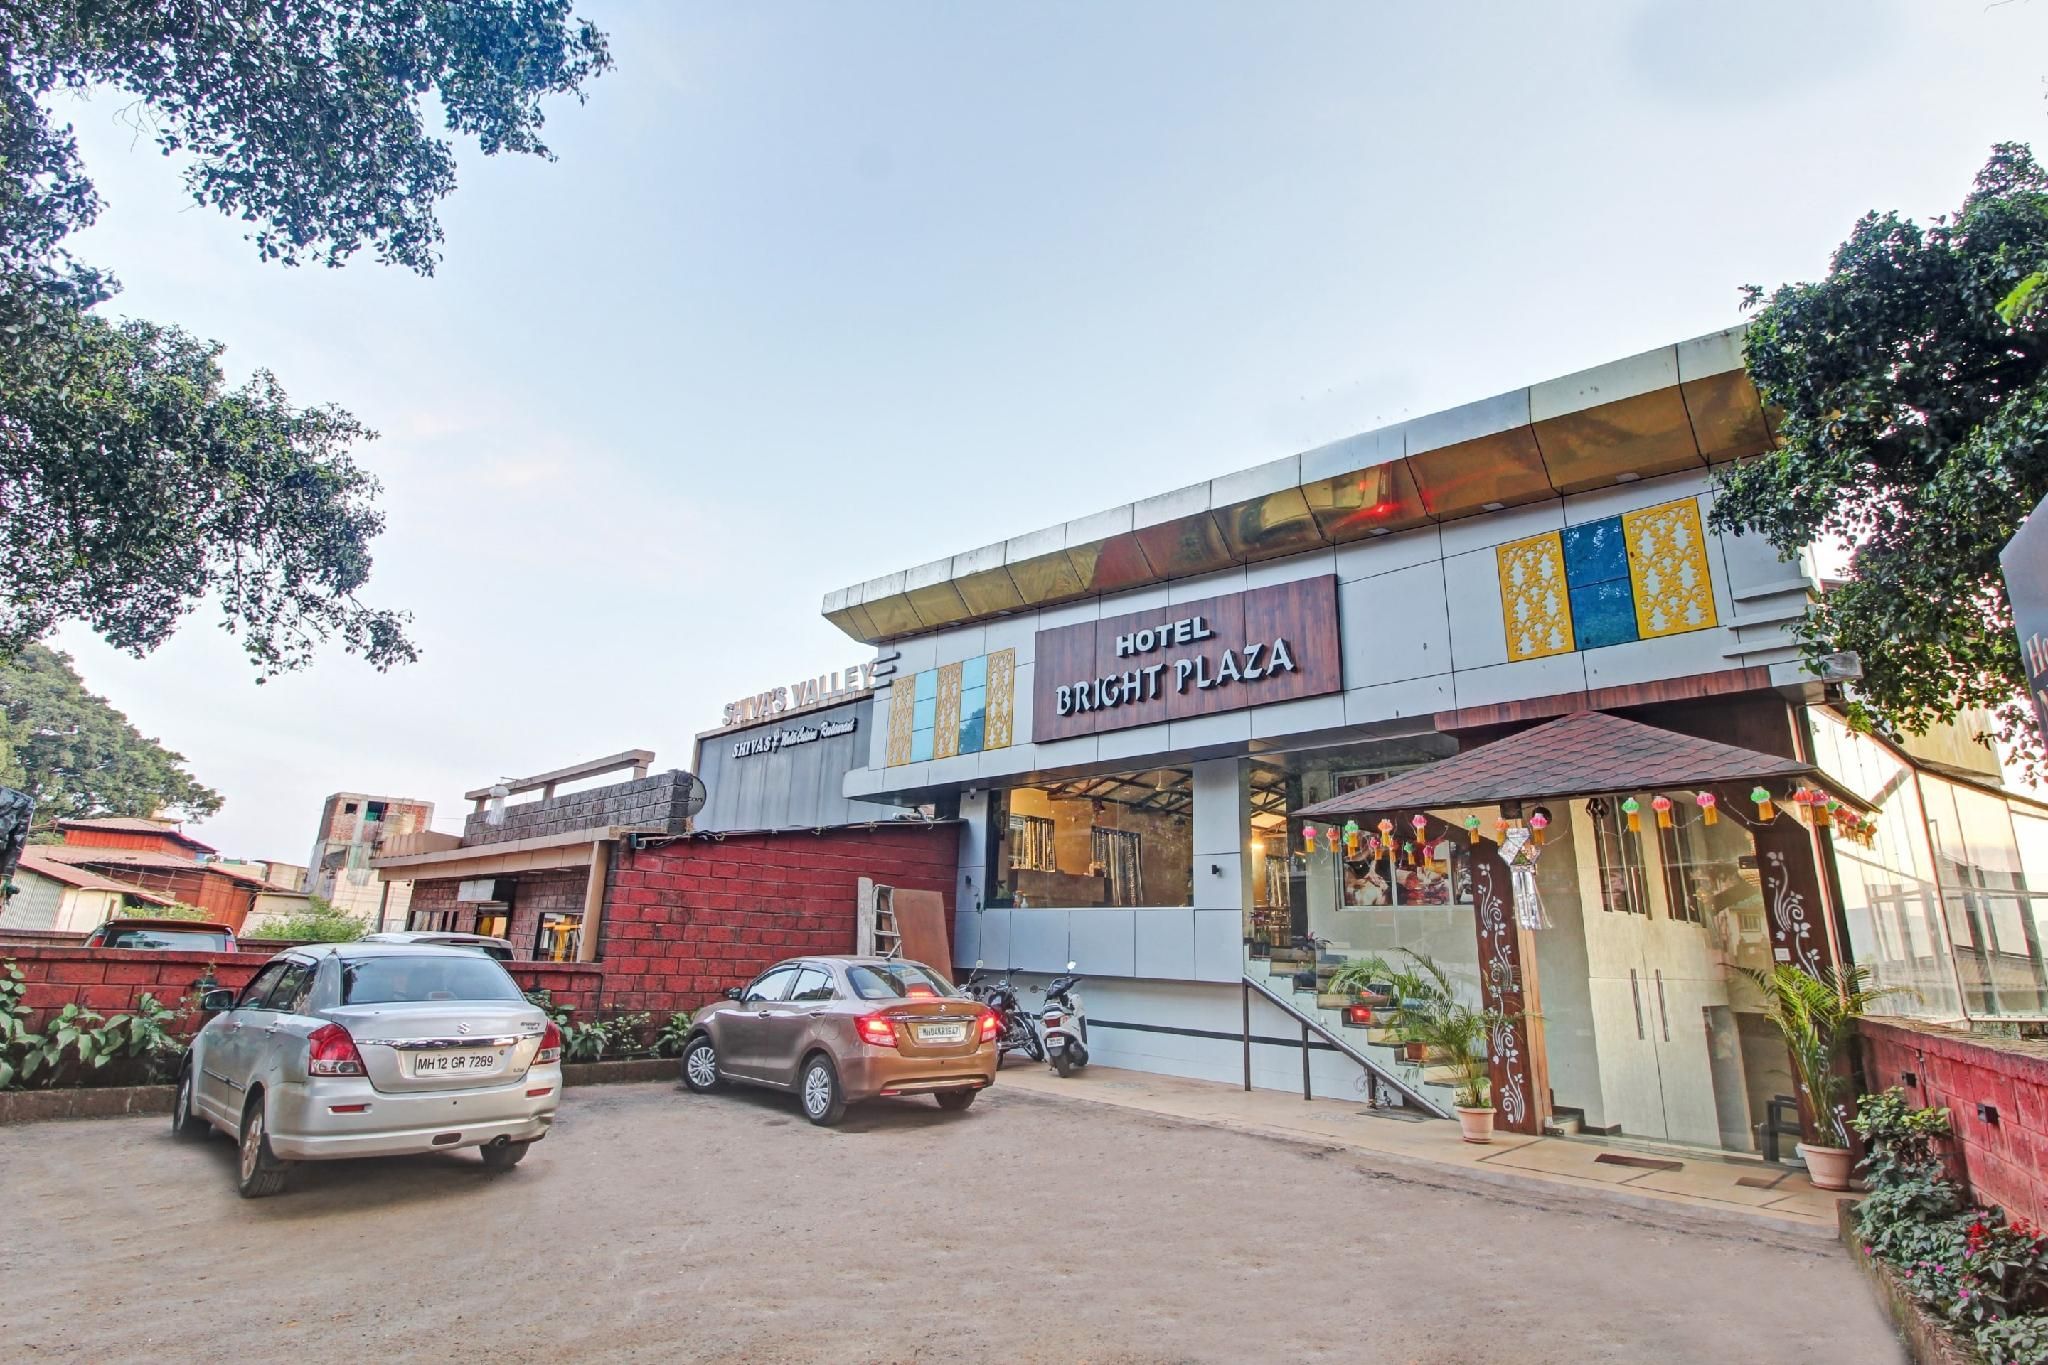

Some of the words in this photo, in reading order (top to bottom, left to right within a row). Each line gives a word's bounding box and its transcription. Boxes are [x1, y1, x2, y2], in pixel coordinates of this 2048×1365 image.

[1115, 615, 1214, 659] HOTEL
[722, 686, 788, 726] SHIVA'S
[791, 661, 876, 708] VALLEY
[1055, 662, 1166, 717] BRIGHT
[1173, 637, 1296, 695] PLAZA
[732, 735, 772, 758] SHIVAS
[417, 1057, 435, 1070] MH
[437, 1056, 448, 1069] 12
[451, 1056, 466, 1068] GR
